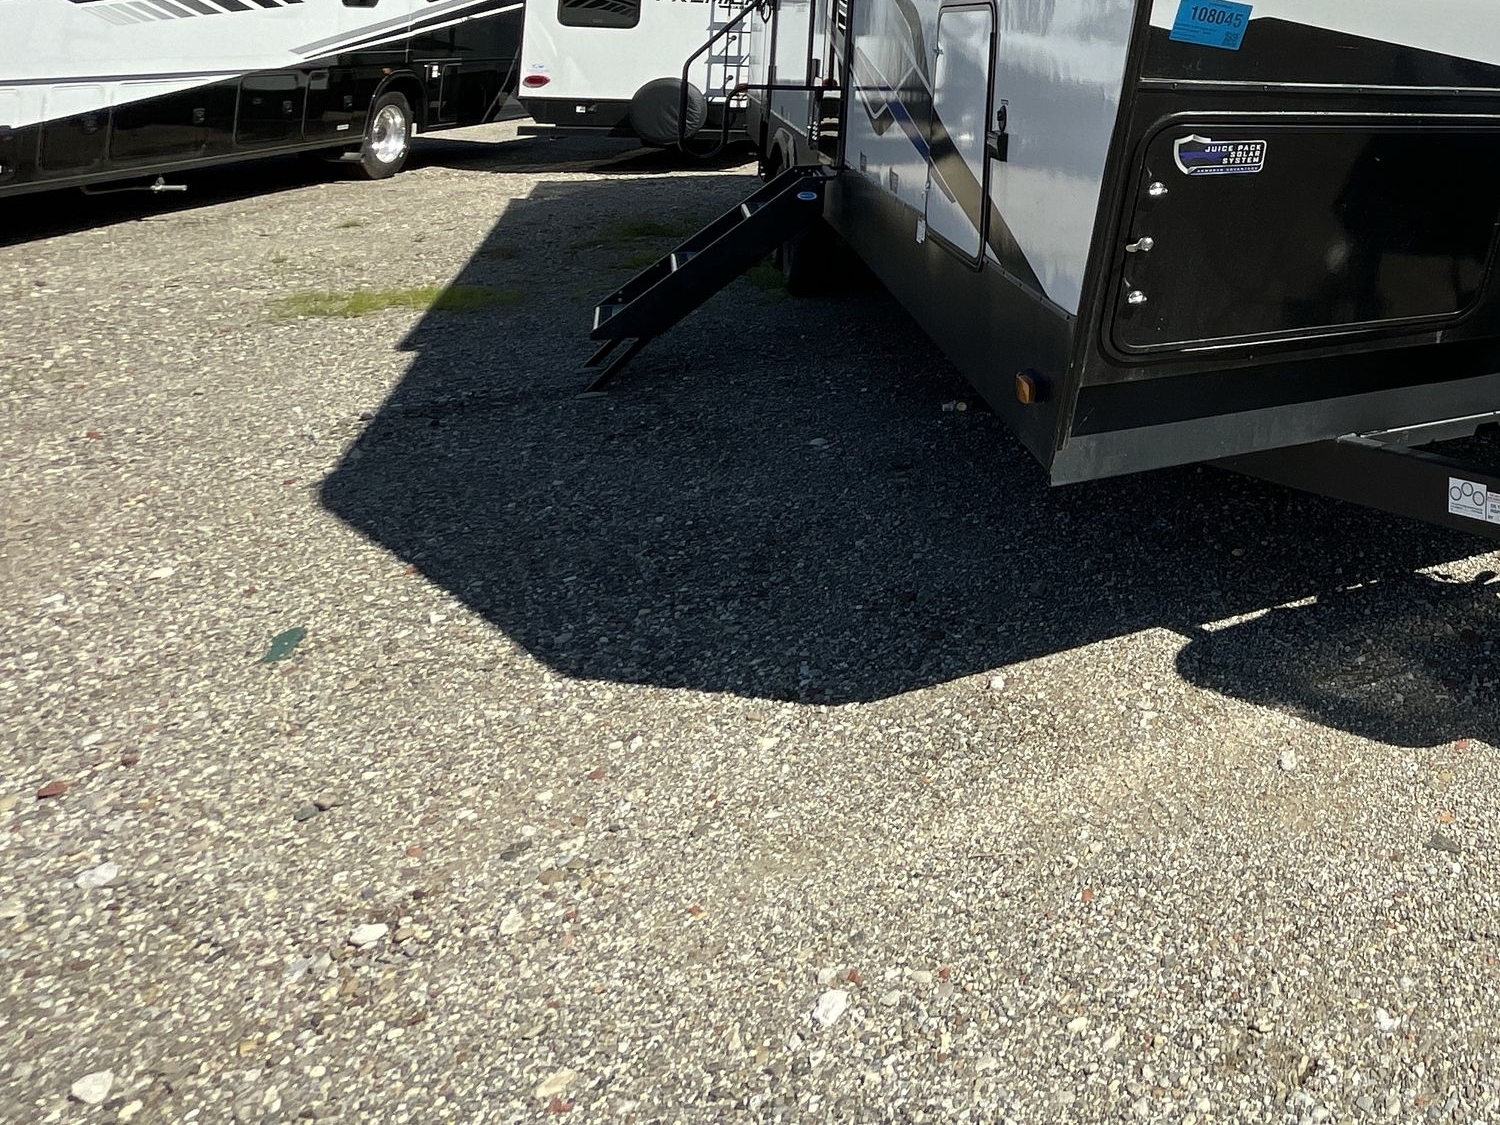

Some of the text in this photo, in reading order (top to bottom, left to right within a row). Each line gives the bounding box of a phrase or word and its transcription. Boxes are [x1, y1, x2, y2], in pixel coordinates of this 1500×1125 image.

[1192, 6, 1243, 28] 108045
[1204, 145, 1234, 153] JUICE
[1222, 157, 1260, 165] SYSTEM
